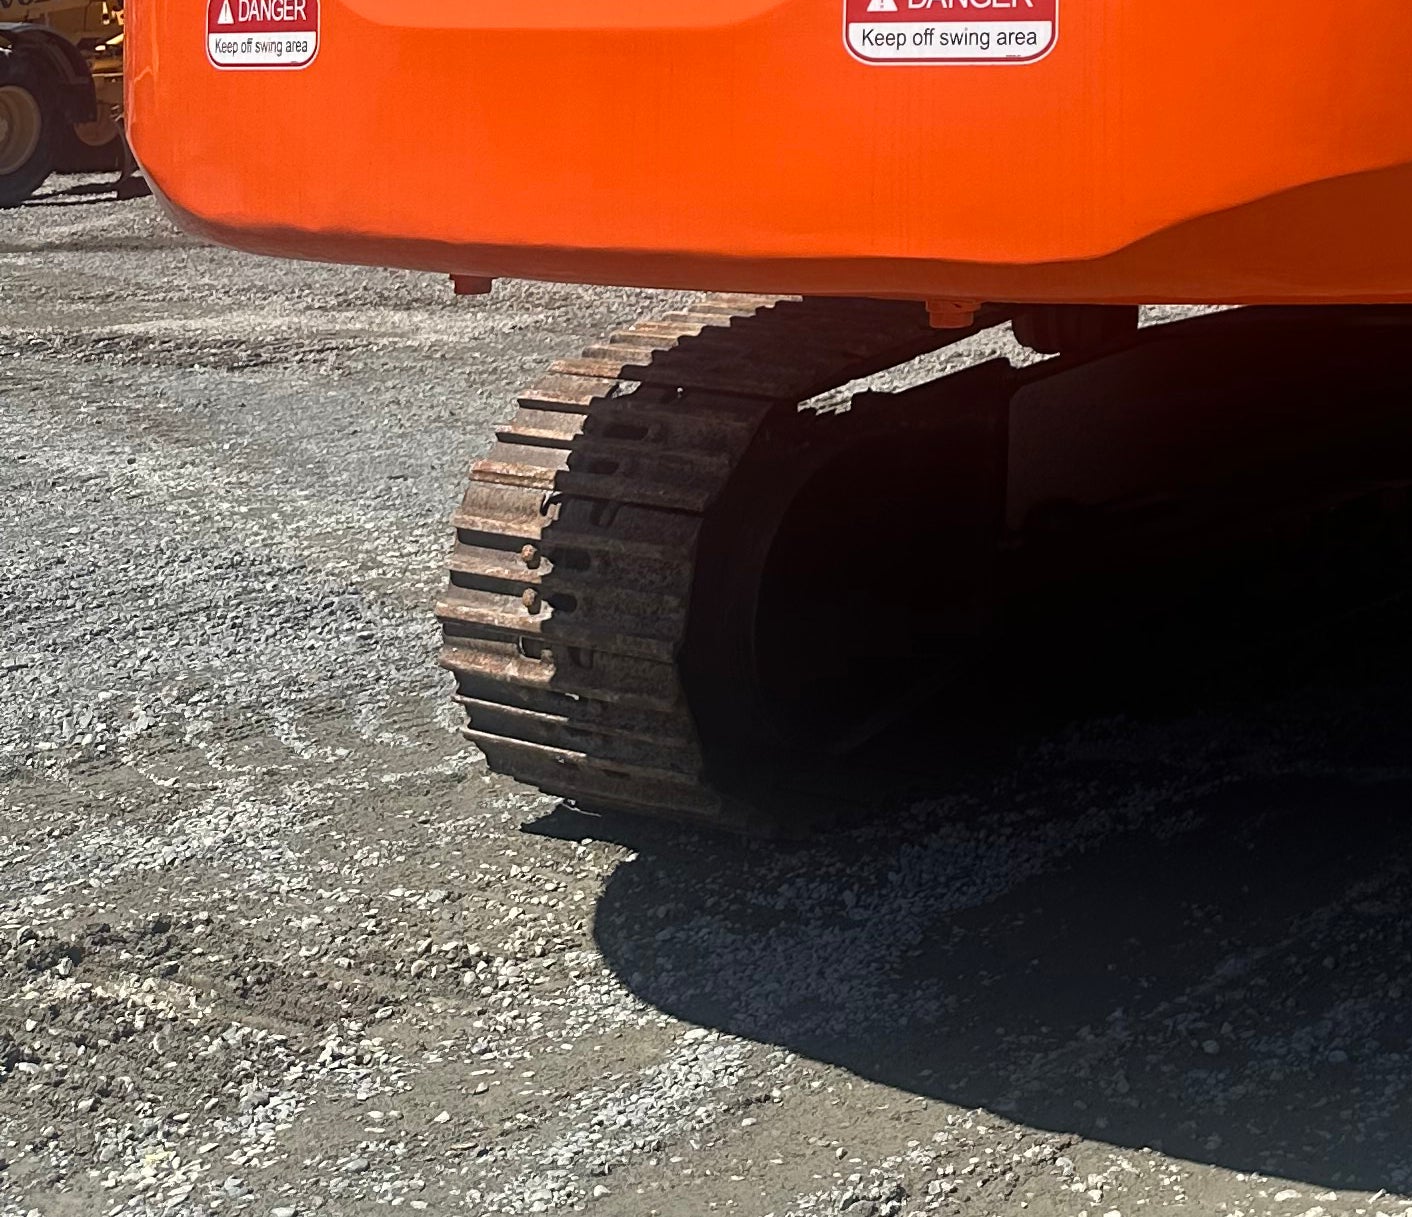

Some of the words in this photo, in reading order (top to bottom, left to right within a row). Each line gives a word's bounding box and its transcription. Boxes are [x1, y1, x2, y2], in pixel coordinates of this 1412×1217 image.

[215, 37, 239, 56] Keep
[241, 38, 254, 54] off
[255, 37, 283, 57] swing
[285, 40, 308, 53] area
[862, 28, 907, 50] Keep
[912, 28, 935, 46] off
[939, 27, 990, 50] swing
[996, 30, 1038, 46] area
